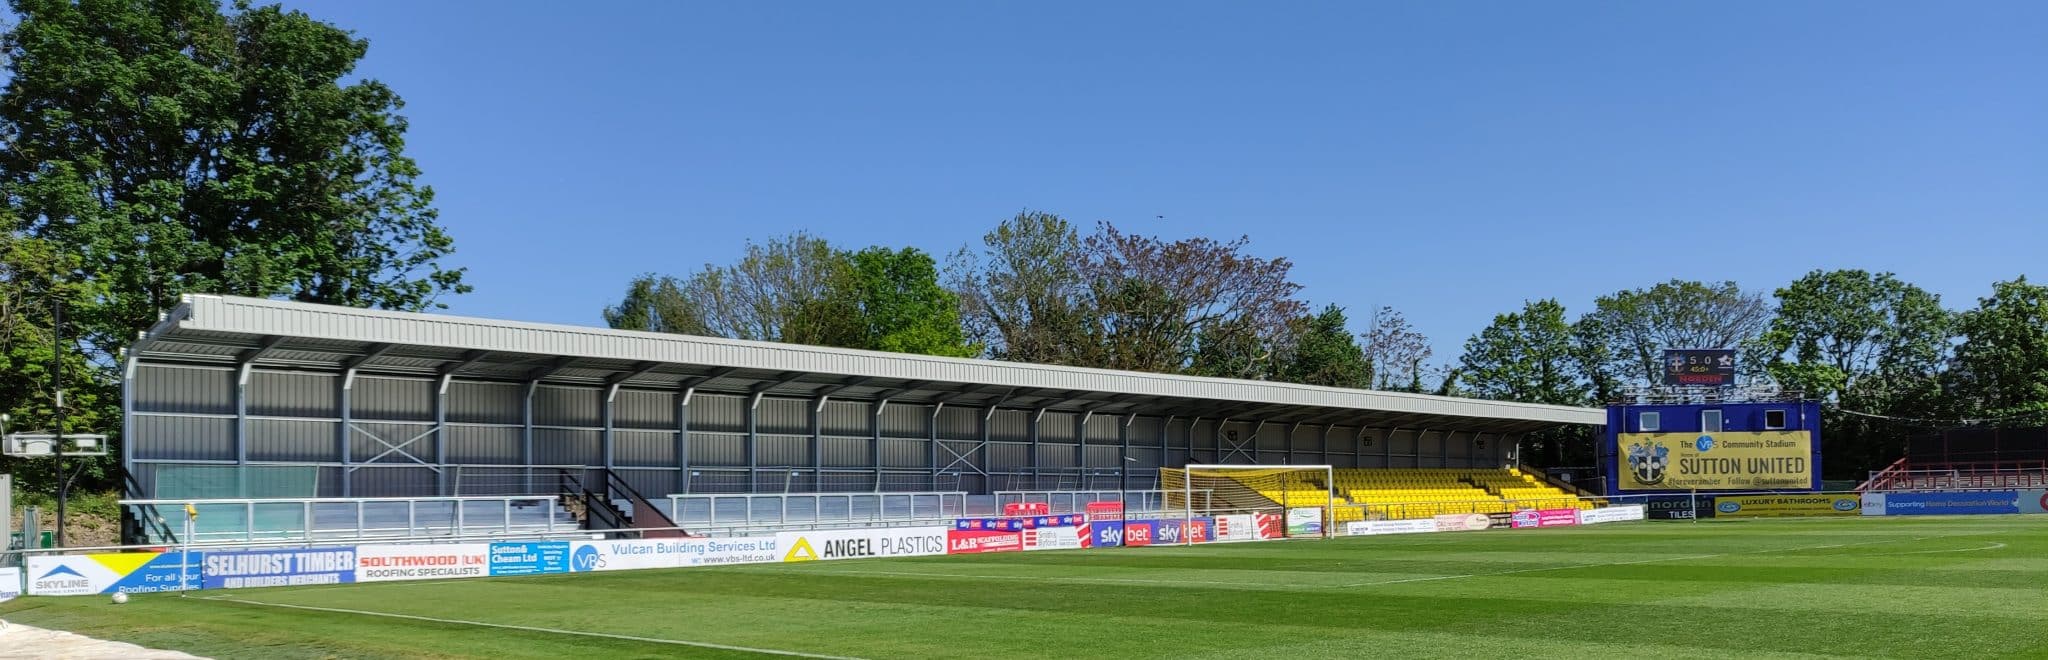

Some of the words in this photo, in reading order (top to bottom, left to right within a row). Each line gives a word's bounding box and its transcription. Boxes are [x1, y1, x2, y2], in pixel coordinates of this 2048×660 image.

[1689, 356, 1697, 365] 5
[1704, 356, 1712, 365] 0
[1680, 441, 1693, 449] The
[1722, 440, 1763, 449] Community
[1766, 440, 1796, 448] Stadium
[1680, 458, 1741, 474] SUTTON
[1747, 457, 1805, 474] UNITED
[1728, 477, 1750, 485] Follow
[1887, 501, 1925, 509] Supporting
[1668, 510, 1694, 519] TILES
[960, 521, 970, 529] sky
[986, 521, 996, 529] sky
[1101, 526, 1123, 546] sky
[1127, 526, 1149, 541] bet
[1159, 525, 1179, 543] sky
[612, 543, 653, 555] Vulcan
[656, 540, 705, 555] Building
[708, 541, 756, 552] Services
[759, 540, 775, 550] Ltd
[824, 538, 875, 558] ANGEL
[881, 536, 942, 555] PLASTICS
[951, 537, 977, 550] L&R
[360, 555, 457, 567] SOUTHWOOD
[492, 554, 521, 563] Cheam
[523, 553, 537, 562] Ltd
[577, 553, 606, 568] VBS
[703, 553, 775, 563] www.vbs-ltd.co.uk
[207, 554, 292, 576] SELHURST
[294, 551, 354, 572] TIMBER
[145, 573, 162, 582] For
[164, 573, 175, 581] all
[366, 568, 414, 578] ROOFING
[417, 567, 480, 576] SPECIALISTS
[35, 579, 89, 589] SKYLINE
[224, 577, 243, 588] AND
[244, 576, 288, 587] BUILDERS
[289, 573, 339, 585] MERCHANTS
[118, 585, 157, 593] Roofing
